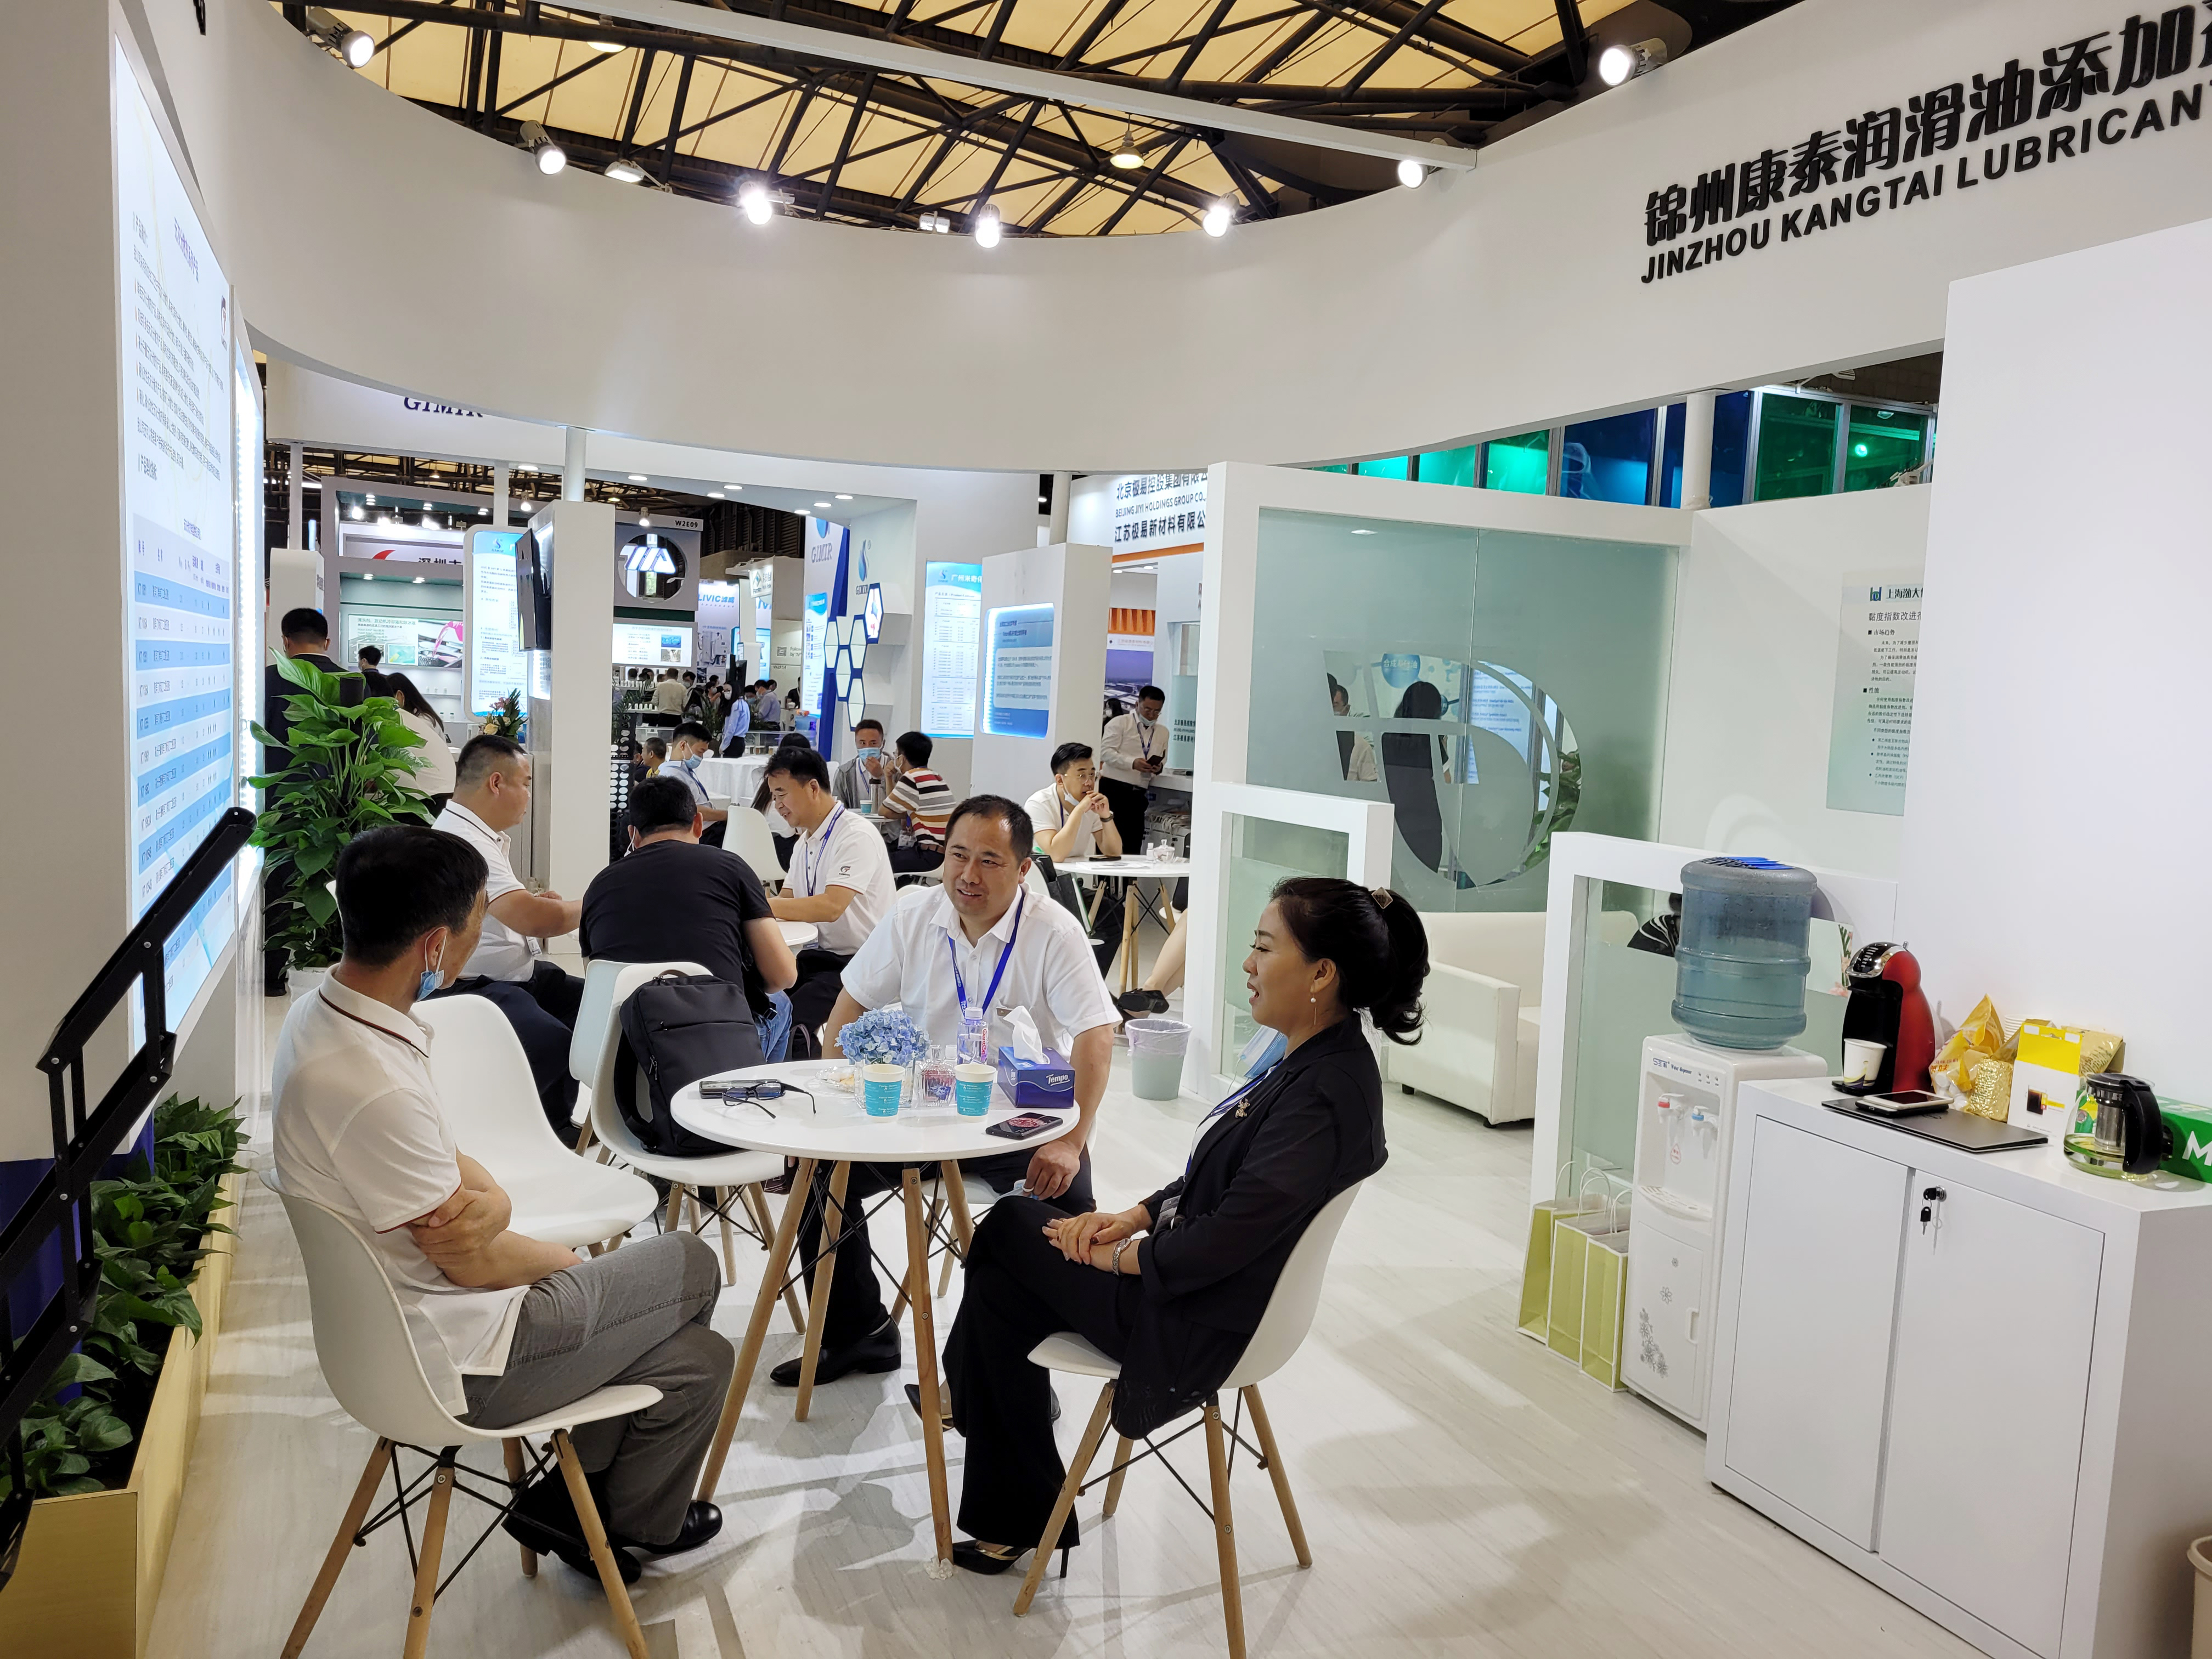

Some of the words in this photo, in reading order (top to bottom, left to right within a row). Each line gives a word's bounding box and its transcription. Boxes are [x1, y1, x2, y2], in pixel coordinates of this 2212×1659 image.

[1645, 0, 2212, 246] 锦州康泰润滑油添加
[1641, 222, 1770, 284] JINZHOU
[1780, 164, 1943, 242] KANGTAI
[1956, 79, 2212, 190] LUBRICAN
[1116, 506, 1134, 518] BEIJING
[1135, 503, 1144, 514] JIYI
[1145, 498, 1173, 512] HOLDINGS
[1173, 493, 1194, 506] GROUP
[811, 543, 832, 563] GIMIR
[1046, 1074, 1070, 1085] Tempo
